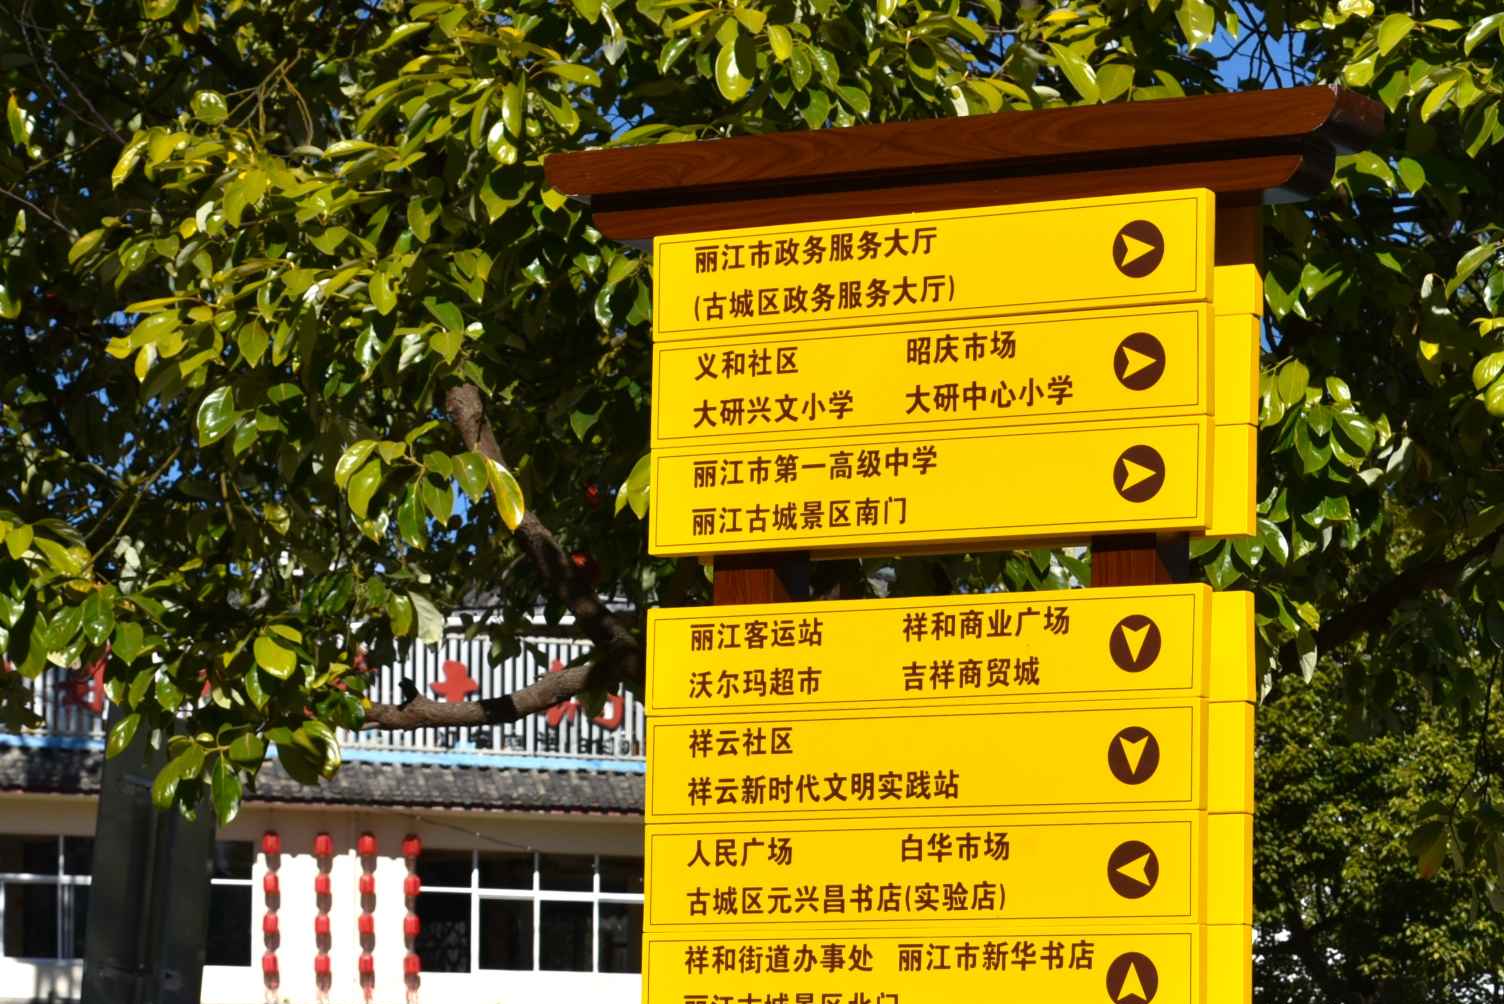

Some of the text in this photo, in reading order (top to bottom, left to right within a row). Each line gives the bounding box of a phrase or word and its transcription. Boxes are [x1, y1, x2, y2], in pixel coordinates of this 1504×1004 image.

[694, 227, 937, 273] 丽江市政务服务大厅
[693, 274, 956, 322] (古城区政务服务大厅)
[694, 347, 800, 381] 义和社区
[906, 330, 1016, 365] 昭庆市场
[693, 390, 854, 428] 大研兴文小学
[905, 375, 1073, 414] 大研中心小学
[693, 445, 937, 489] 丽江市第一高级中学
[692, 497, 907, 536] 丽江古城景区南门
[690, 617, 823, 651] 丽江客运站
[902, 605, 1070, 642] 祥和商业广场
[688, 665, 822, 699] 沃尔玛超市
[902, 656, 1040, 692] 吉祥商贸城
[688, 726, 794, 758] 祥云社区
[687, 769, 960, 806] 祥云新时代文明实践站
[687, 837, 793, 868] 人民广场
[900, 831, 1010, 863] 白华市场
[686, 881, 1007, 917] 古城区元兴昌书店(实验店)
[684, 942, 874, 975] 祥和街道办事处
[897, 939, 1095, 972] 丽江市新华书店
